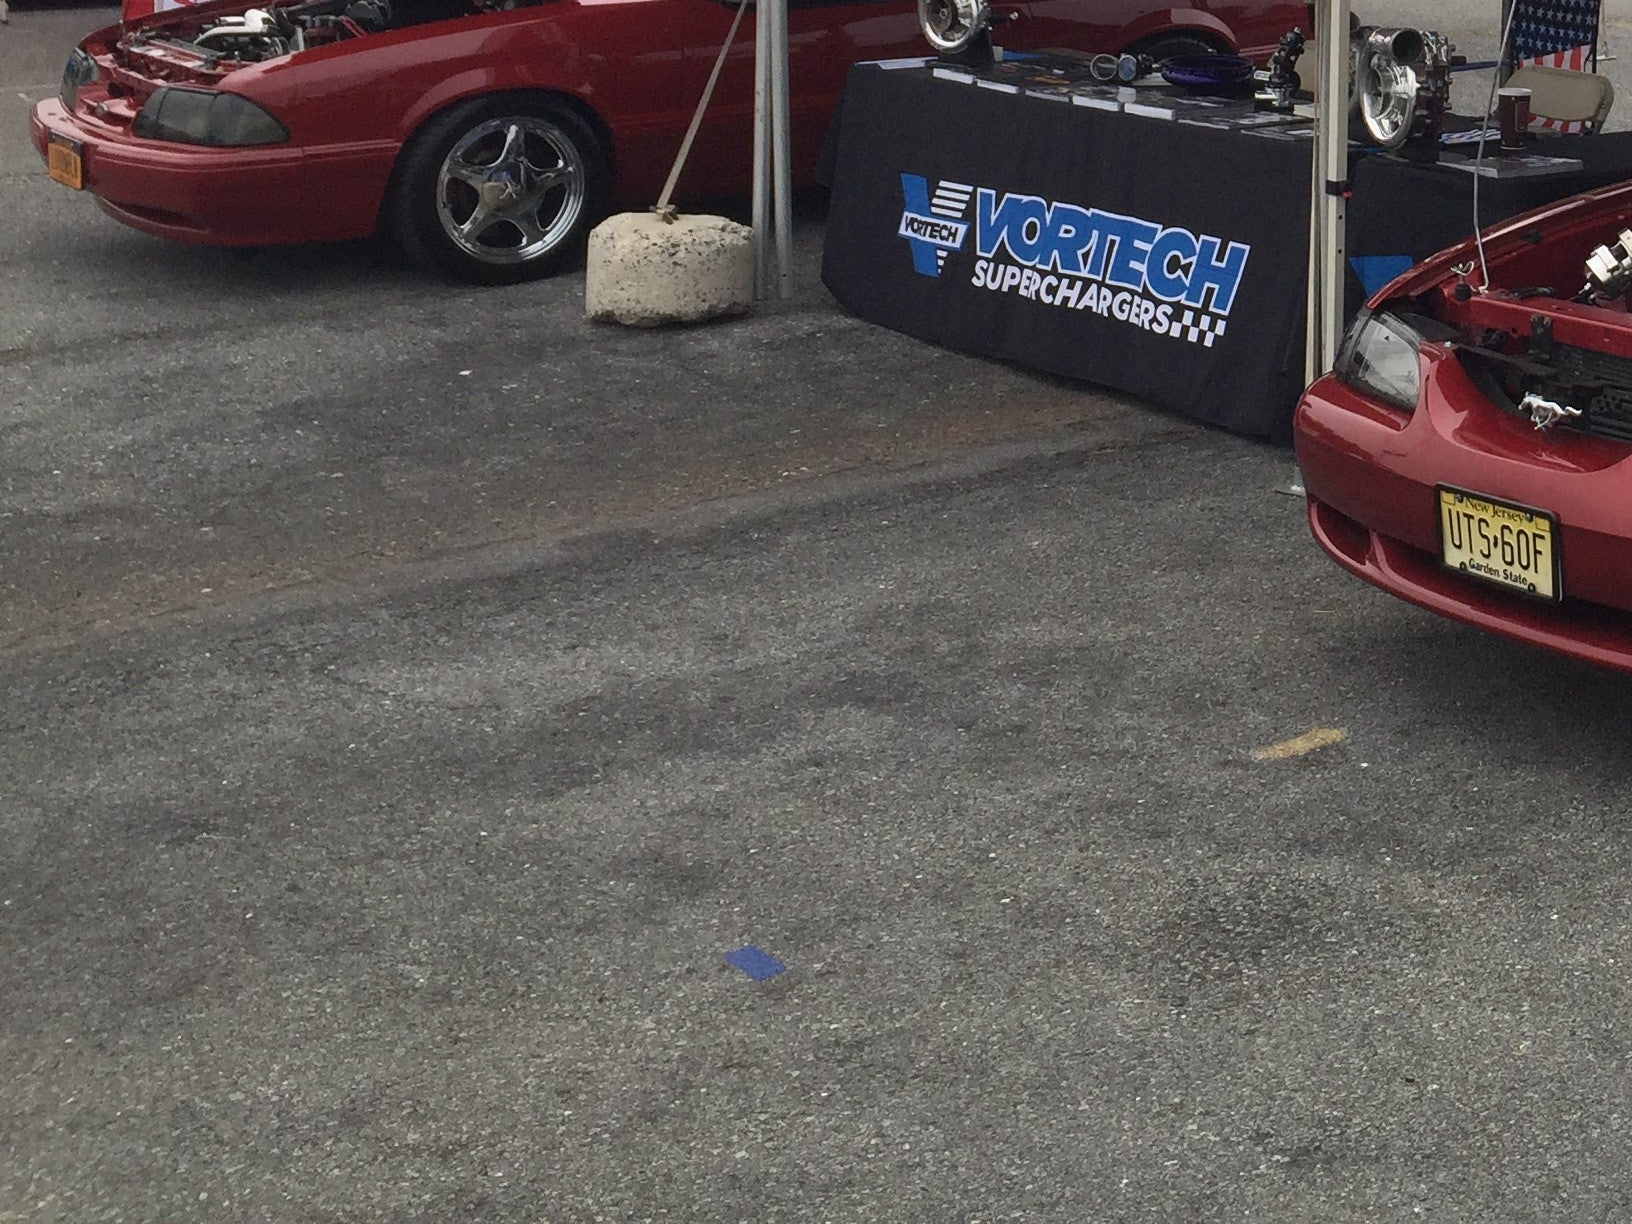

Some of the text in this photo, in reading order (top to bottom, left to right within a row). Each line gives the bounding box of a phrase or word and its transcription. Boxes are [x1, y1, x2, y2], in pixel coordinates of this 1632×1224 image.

[903, 214, 960, 248] VORTECH
[977, 187, 1251, 316] VORTECH
[971, 259, 1174, 337] SUPERCHARGERS
[1465, 497, 1524, 526] New Jersey
[1468, 557, 1528, 586] Garden State
